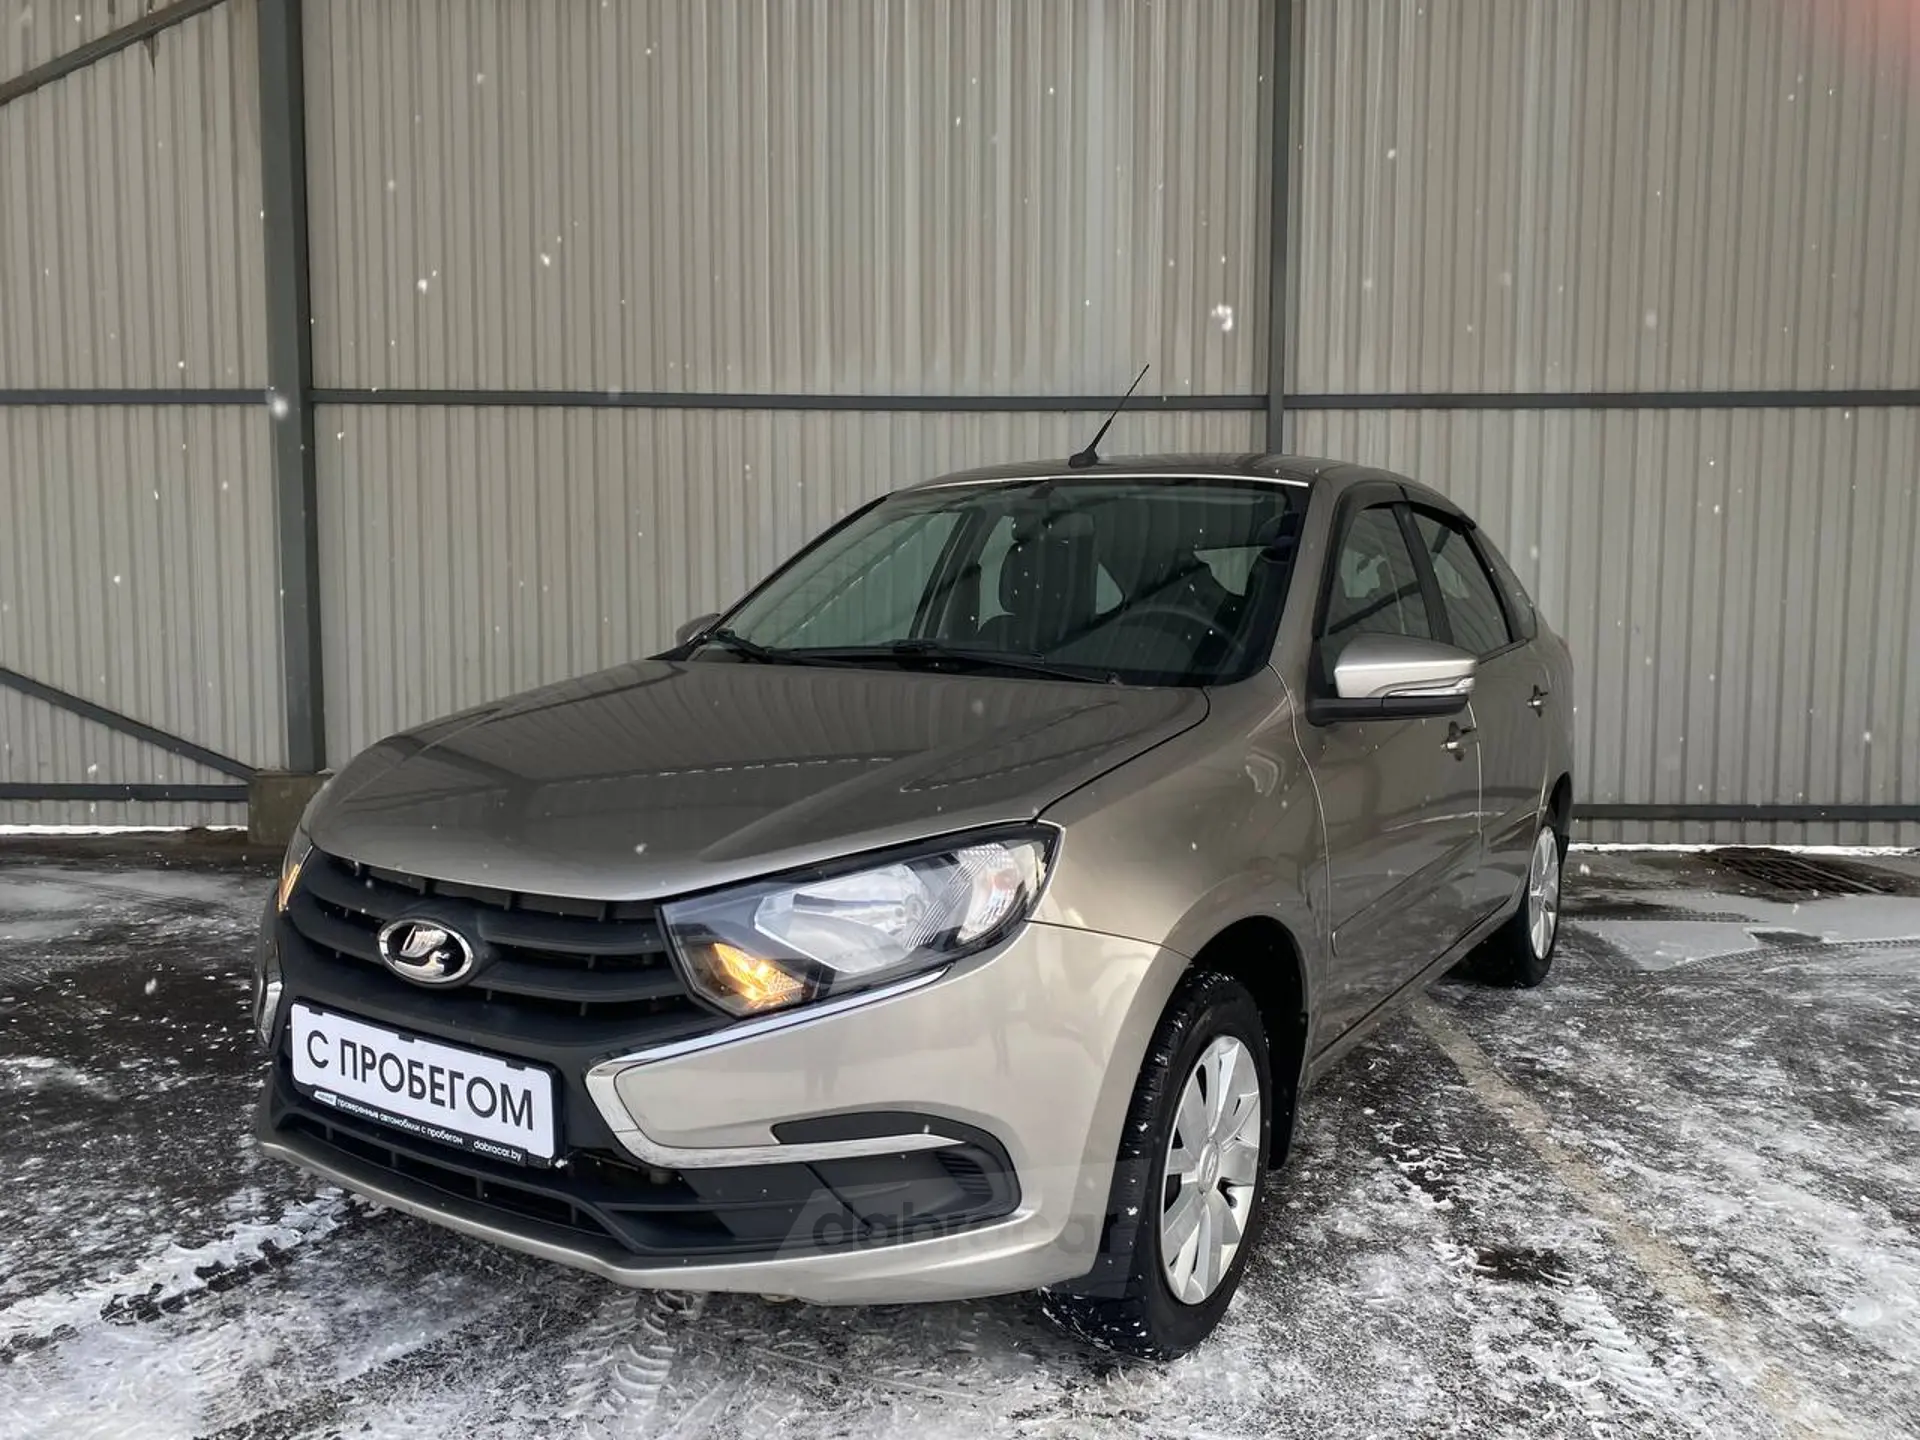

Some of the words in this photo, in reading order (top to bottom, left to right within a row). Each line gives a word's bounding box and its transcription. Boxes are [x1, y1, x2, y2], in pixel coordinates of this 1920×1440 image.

[306, 1030, 329, 1068] С
[340, 1038, 534, 1131] ПРОБЕГОМ
[379, 1114, 421, 1132] автомобили
[427, 1128, 463, 1145] пробегом
